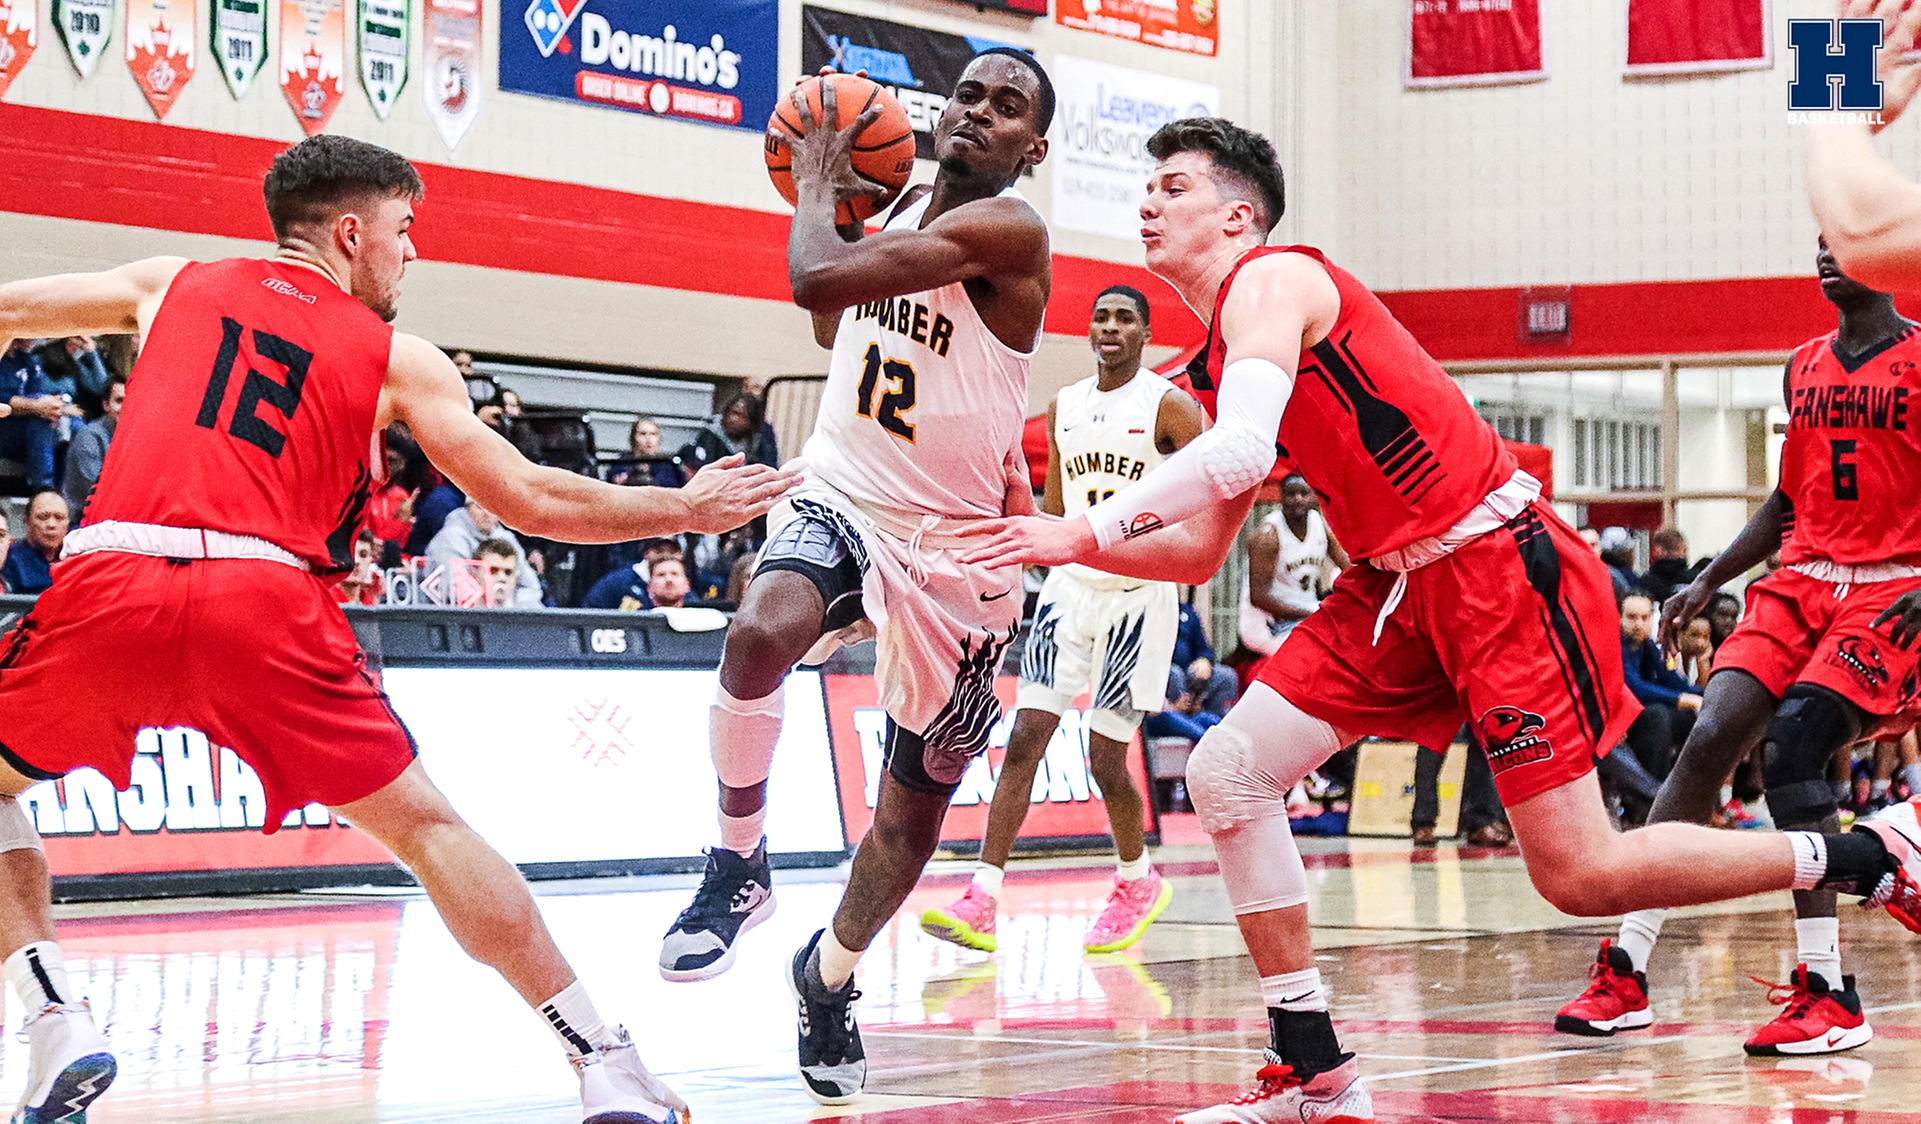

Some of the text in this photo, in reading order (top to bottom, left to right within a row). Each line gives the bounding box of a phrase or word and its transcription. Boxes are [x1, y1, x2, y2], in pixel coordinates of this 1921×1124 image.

[581, 12, 739, 89] Domino's
[195, 316, 314, 459] 12
[857, 341, 917, 444] 12
[1791, 385, 1909, 431] FANSHAWE
[1830, 439, 1859, 501] 6
